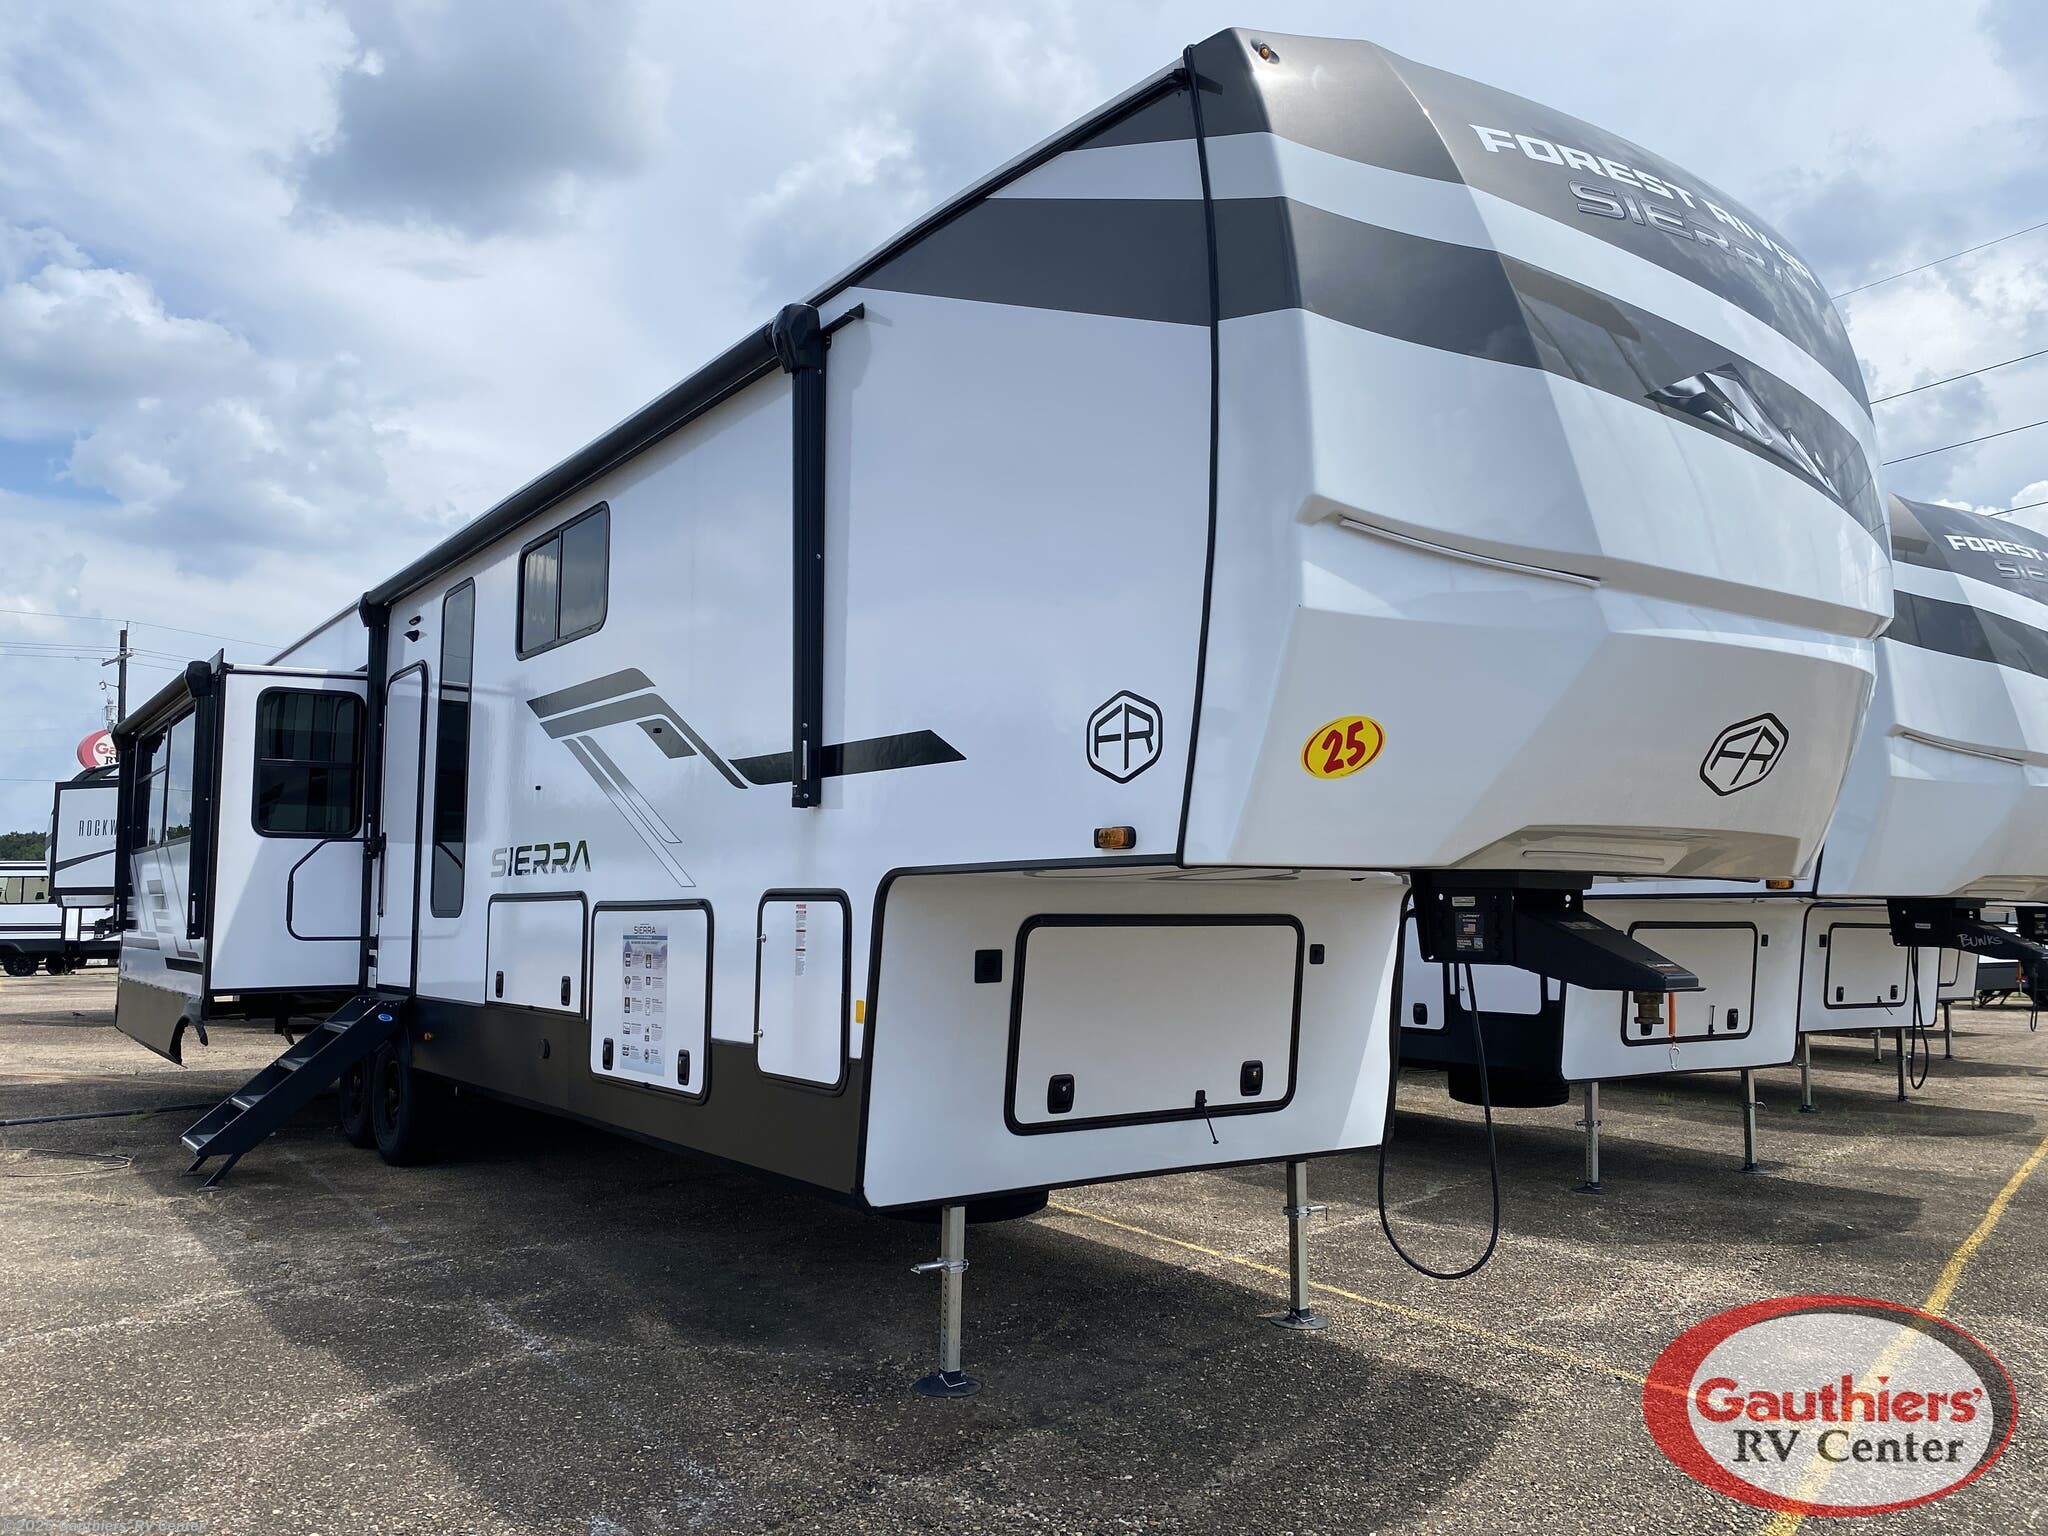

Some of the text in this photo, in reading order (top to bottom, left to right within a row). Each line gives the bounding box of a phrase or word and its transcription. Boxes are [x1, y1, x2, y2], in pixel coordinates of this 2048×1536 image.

[1468, 123, 1820, 290] FOREST RIVER
[1944, 534, 2043, 561] FOREST
[1321, 719, 1366, 774] 25
[490, 839, 592, 878] SIERRA
[633, 926, 657, 935] SIERRA
[1958, 933, 2003, 948] BUNKS
